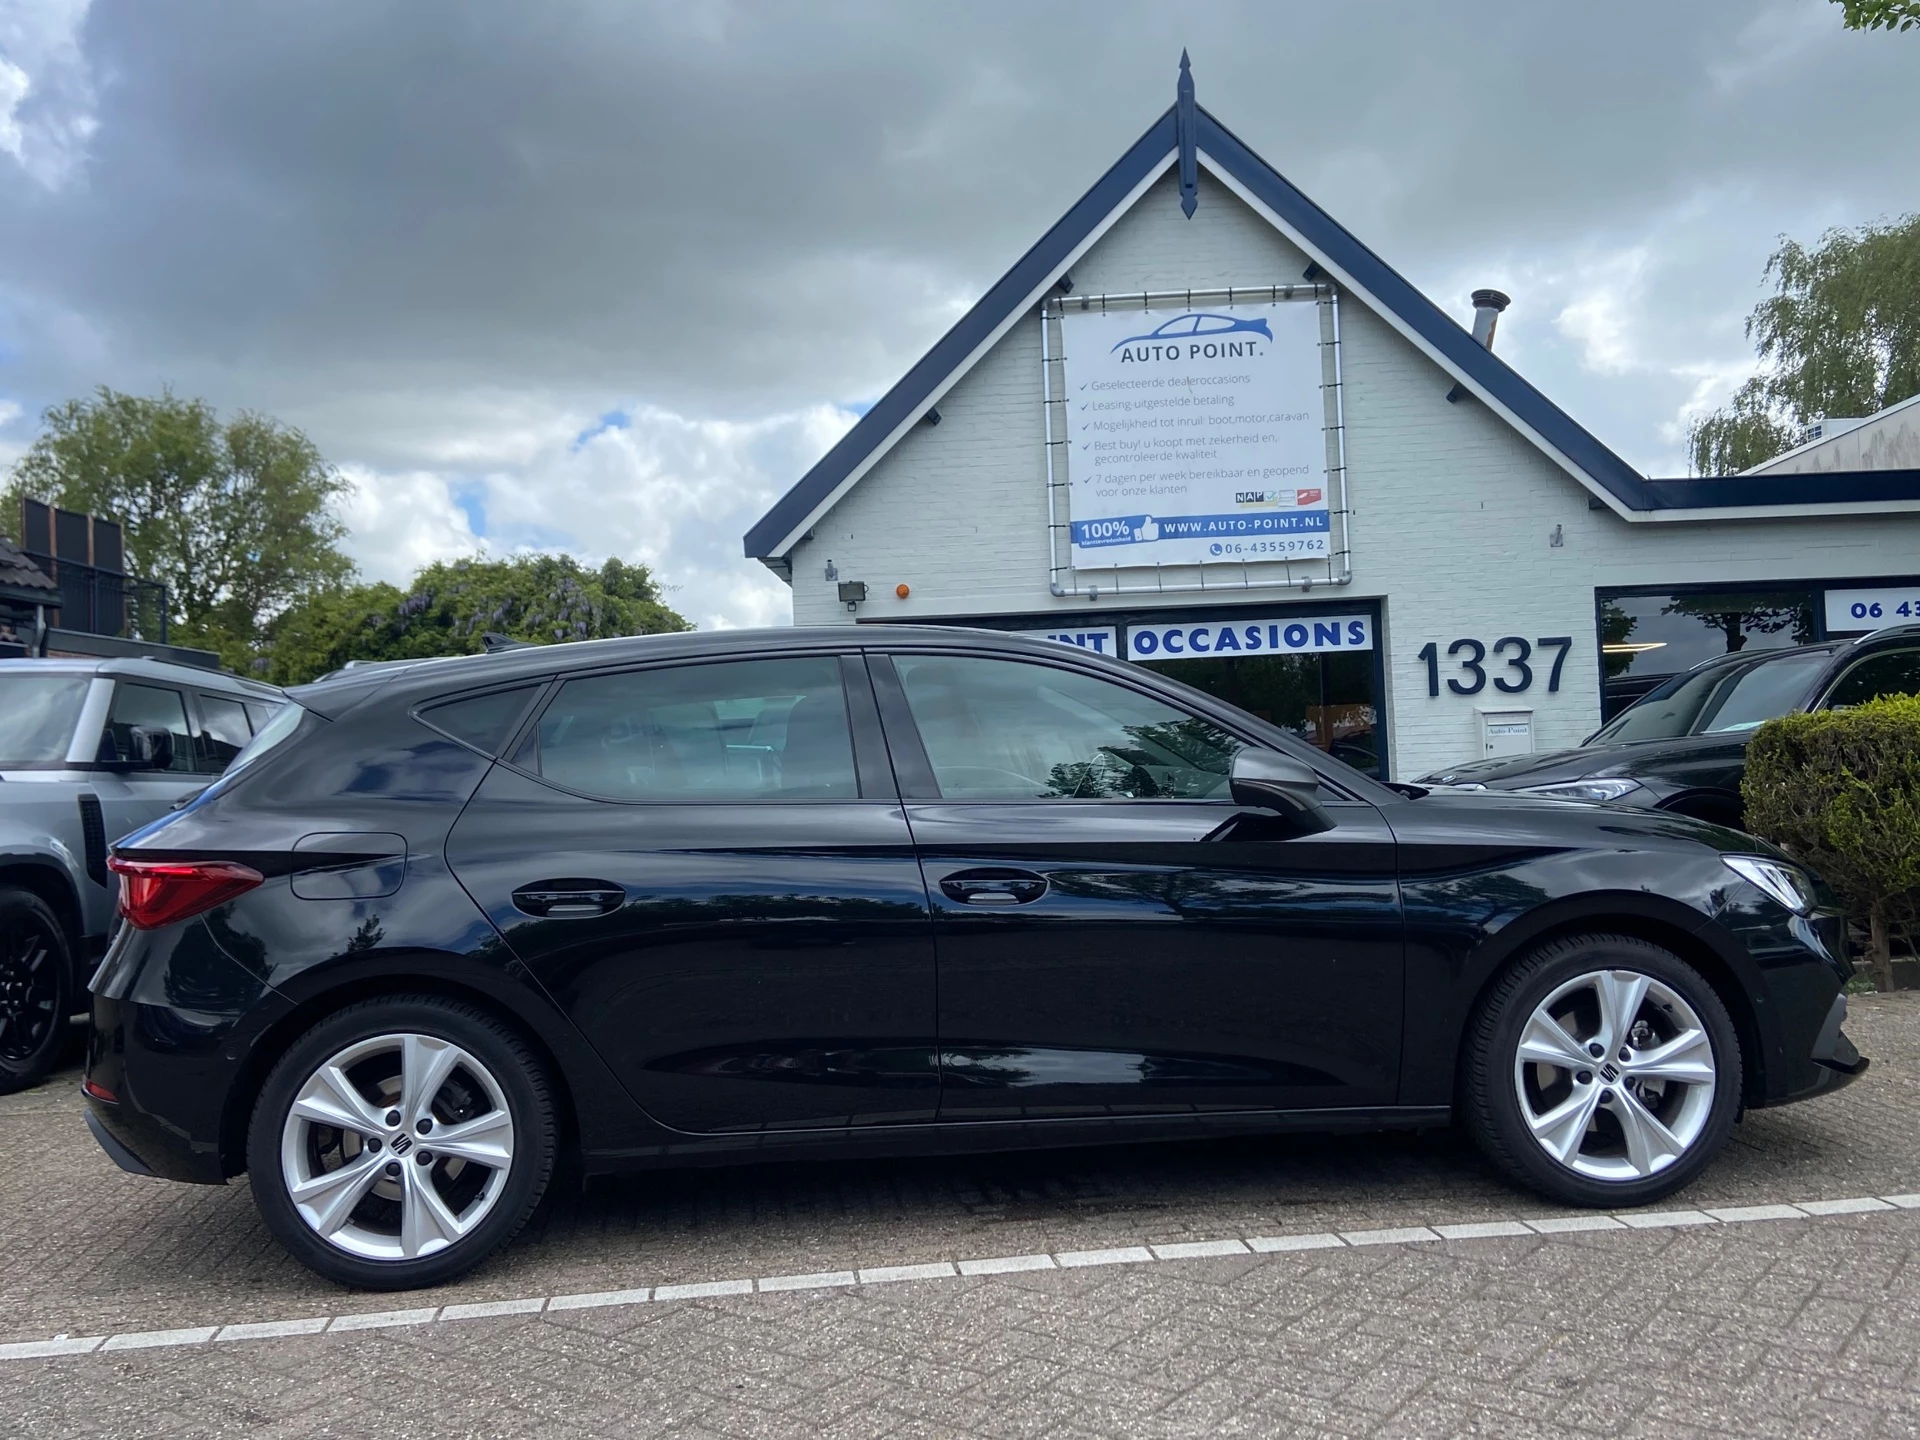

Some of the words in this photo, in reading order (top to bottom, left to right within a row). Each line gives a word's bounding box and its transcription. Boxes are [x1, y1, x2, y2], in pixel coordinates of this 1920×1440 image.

[1121, 346, 1180, 363] AUTO
[1190, 342, 1264, 360] POINT.
[1091, 378, 1165, 391] Geselecteerde
[1168, 374, 1251, 388] dealeroccasions
[1092, 397, 1190, 412] Leasing-uitgestelde
[1194, 395, 1235, 407] betaling
[1094, 418, 1157, 432] Mogelijkheid
[1160, 418, 1174, 428] tot
[1208, 412, 1310, 426] boot,motor,caravan
[1094, 440, 1117, 451] Best
[1120, 439, 1142, 452] buy!
[1144, 440, 1150, 448] u
[1154, 437, 1183, 450] koopt
[1186, 436, 1206, 446] met
[1208, 433, 1259, 445] zekerheid
[1094, 450, 1173, 466] gecontroleerde
[1176, 450, 1217, 460] kwaliteit
[1096, 474, 1102, 484] 7
[1105, 472, 1137, 486] dagen
[1140, 473, 1158, 485] per
[1160, 469, 1186, 481] week
[1190, 467, 1244, 480] bereikbaar
[1248, 468, 1260, 477] en
[1263, 464, 1309, 478] geopend
[1096, 488, 1119, 498] voor
[1122, 486, 1147, 496] onze
[1150, 485, 1188, 495] klanten
[1236, 491, 1264, 503] NAP
[1081, 520, 1130, 539] 100%
[1164, 516, 1324, 533] WWW.AUTO-POINT.NL
[1225, 539, 1324, 554] 06-43559762
[1850, 602, 1883, 619] 06
[1134, 620, 1365, 655] OCCASIONS
[1418, 636, 1572, 697] 1337
[1488, 726, 1528, 734] Auto-Point
